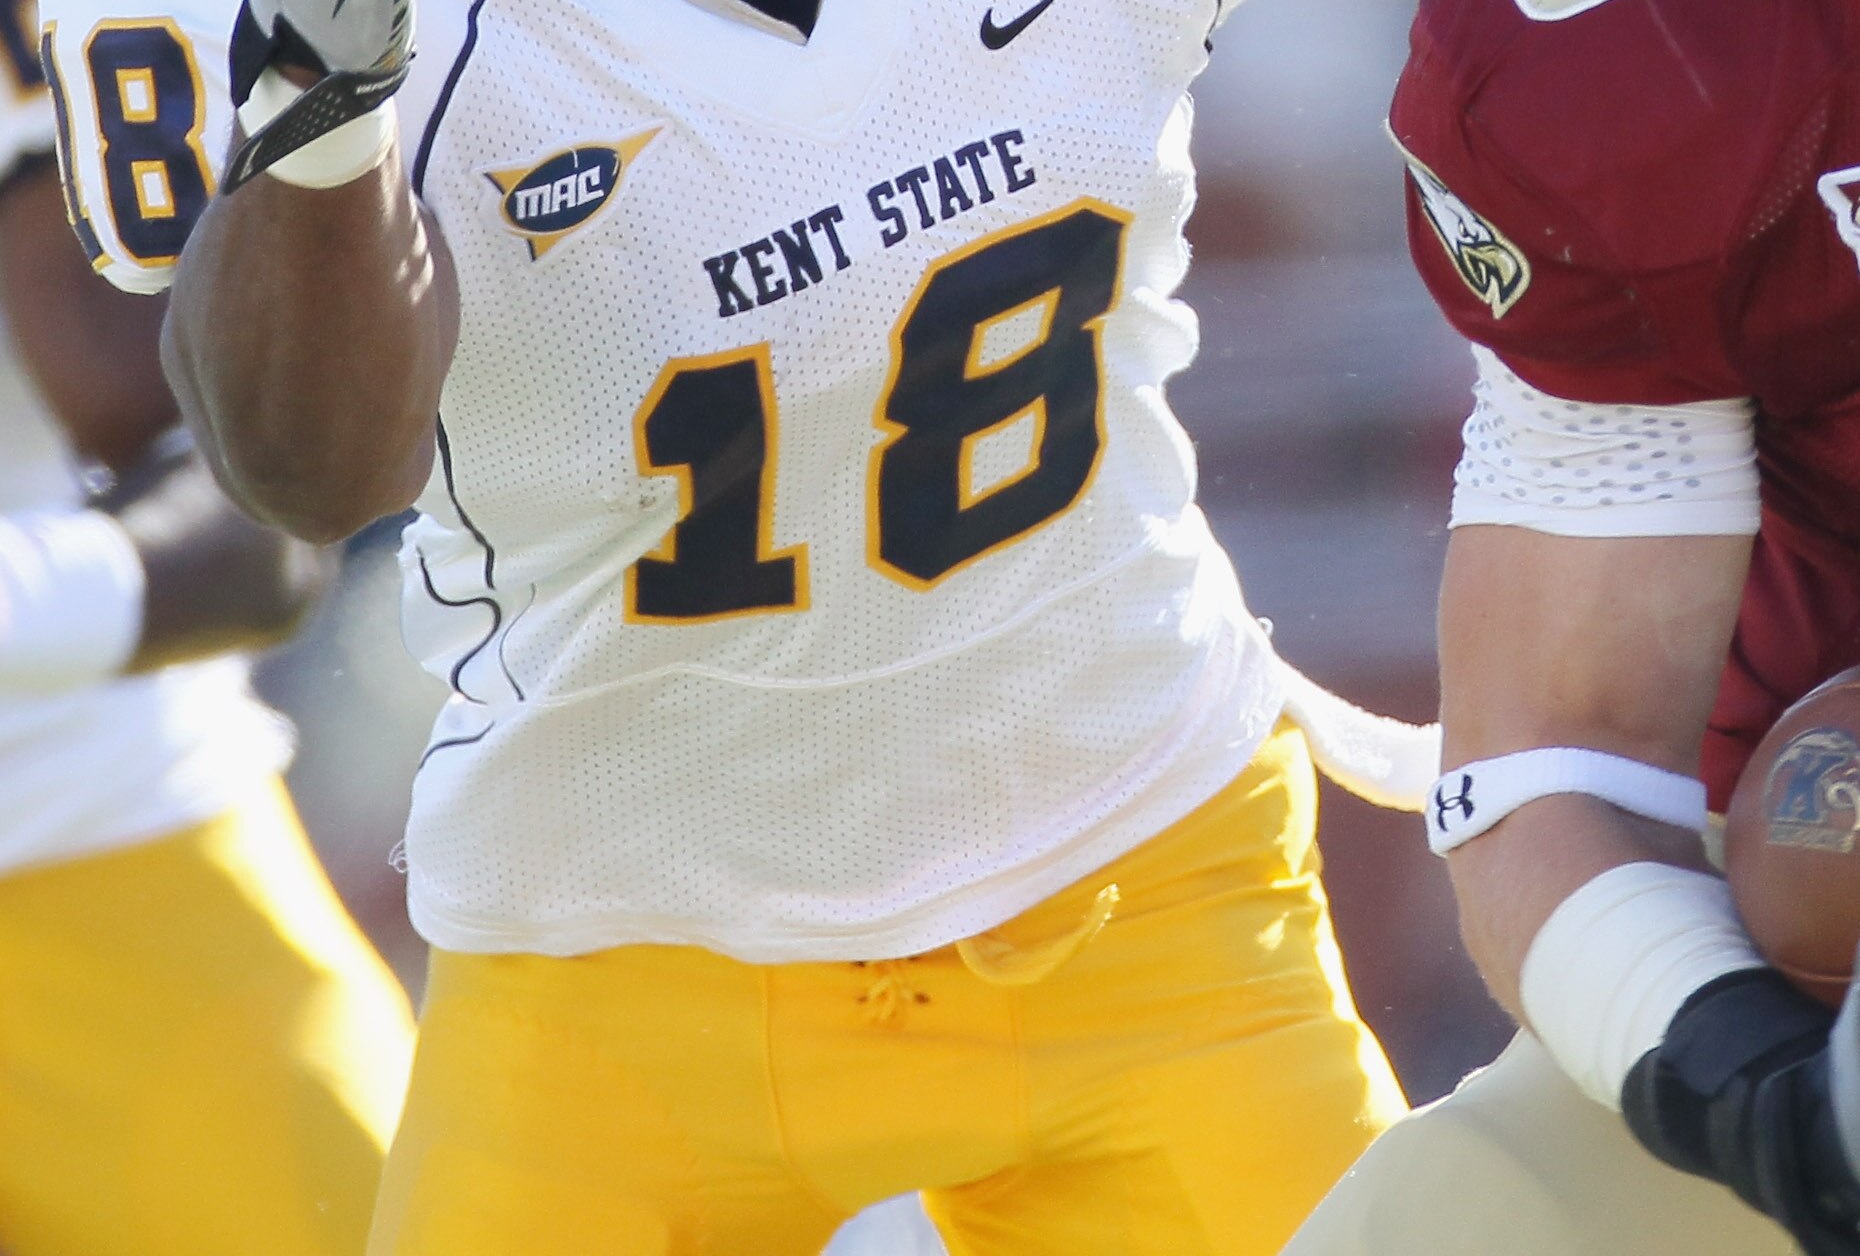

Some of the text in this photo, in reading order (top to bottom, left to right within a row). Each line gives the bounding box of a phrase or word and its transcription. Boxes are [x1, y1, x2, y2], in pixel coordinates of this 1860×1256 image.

[514, 164, 605, 221] MAC
[703, 128, 1037, 319] KENT STATE
[622, 195, 1135, 625] 18
